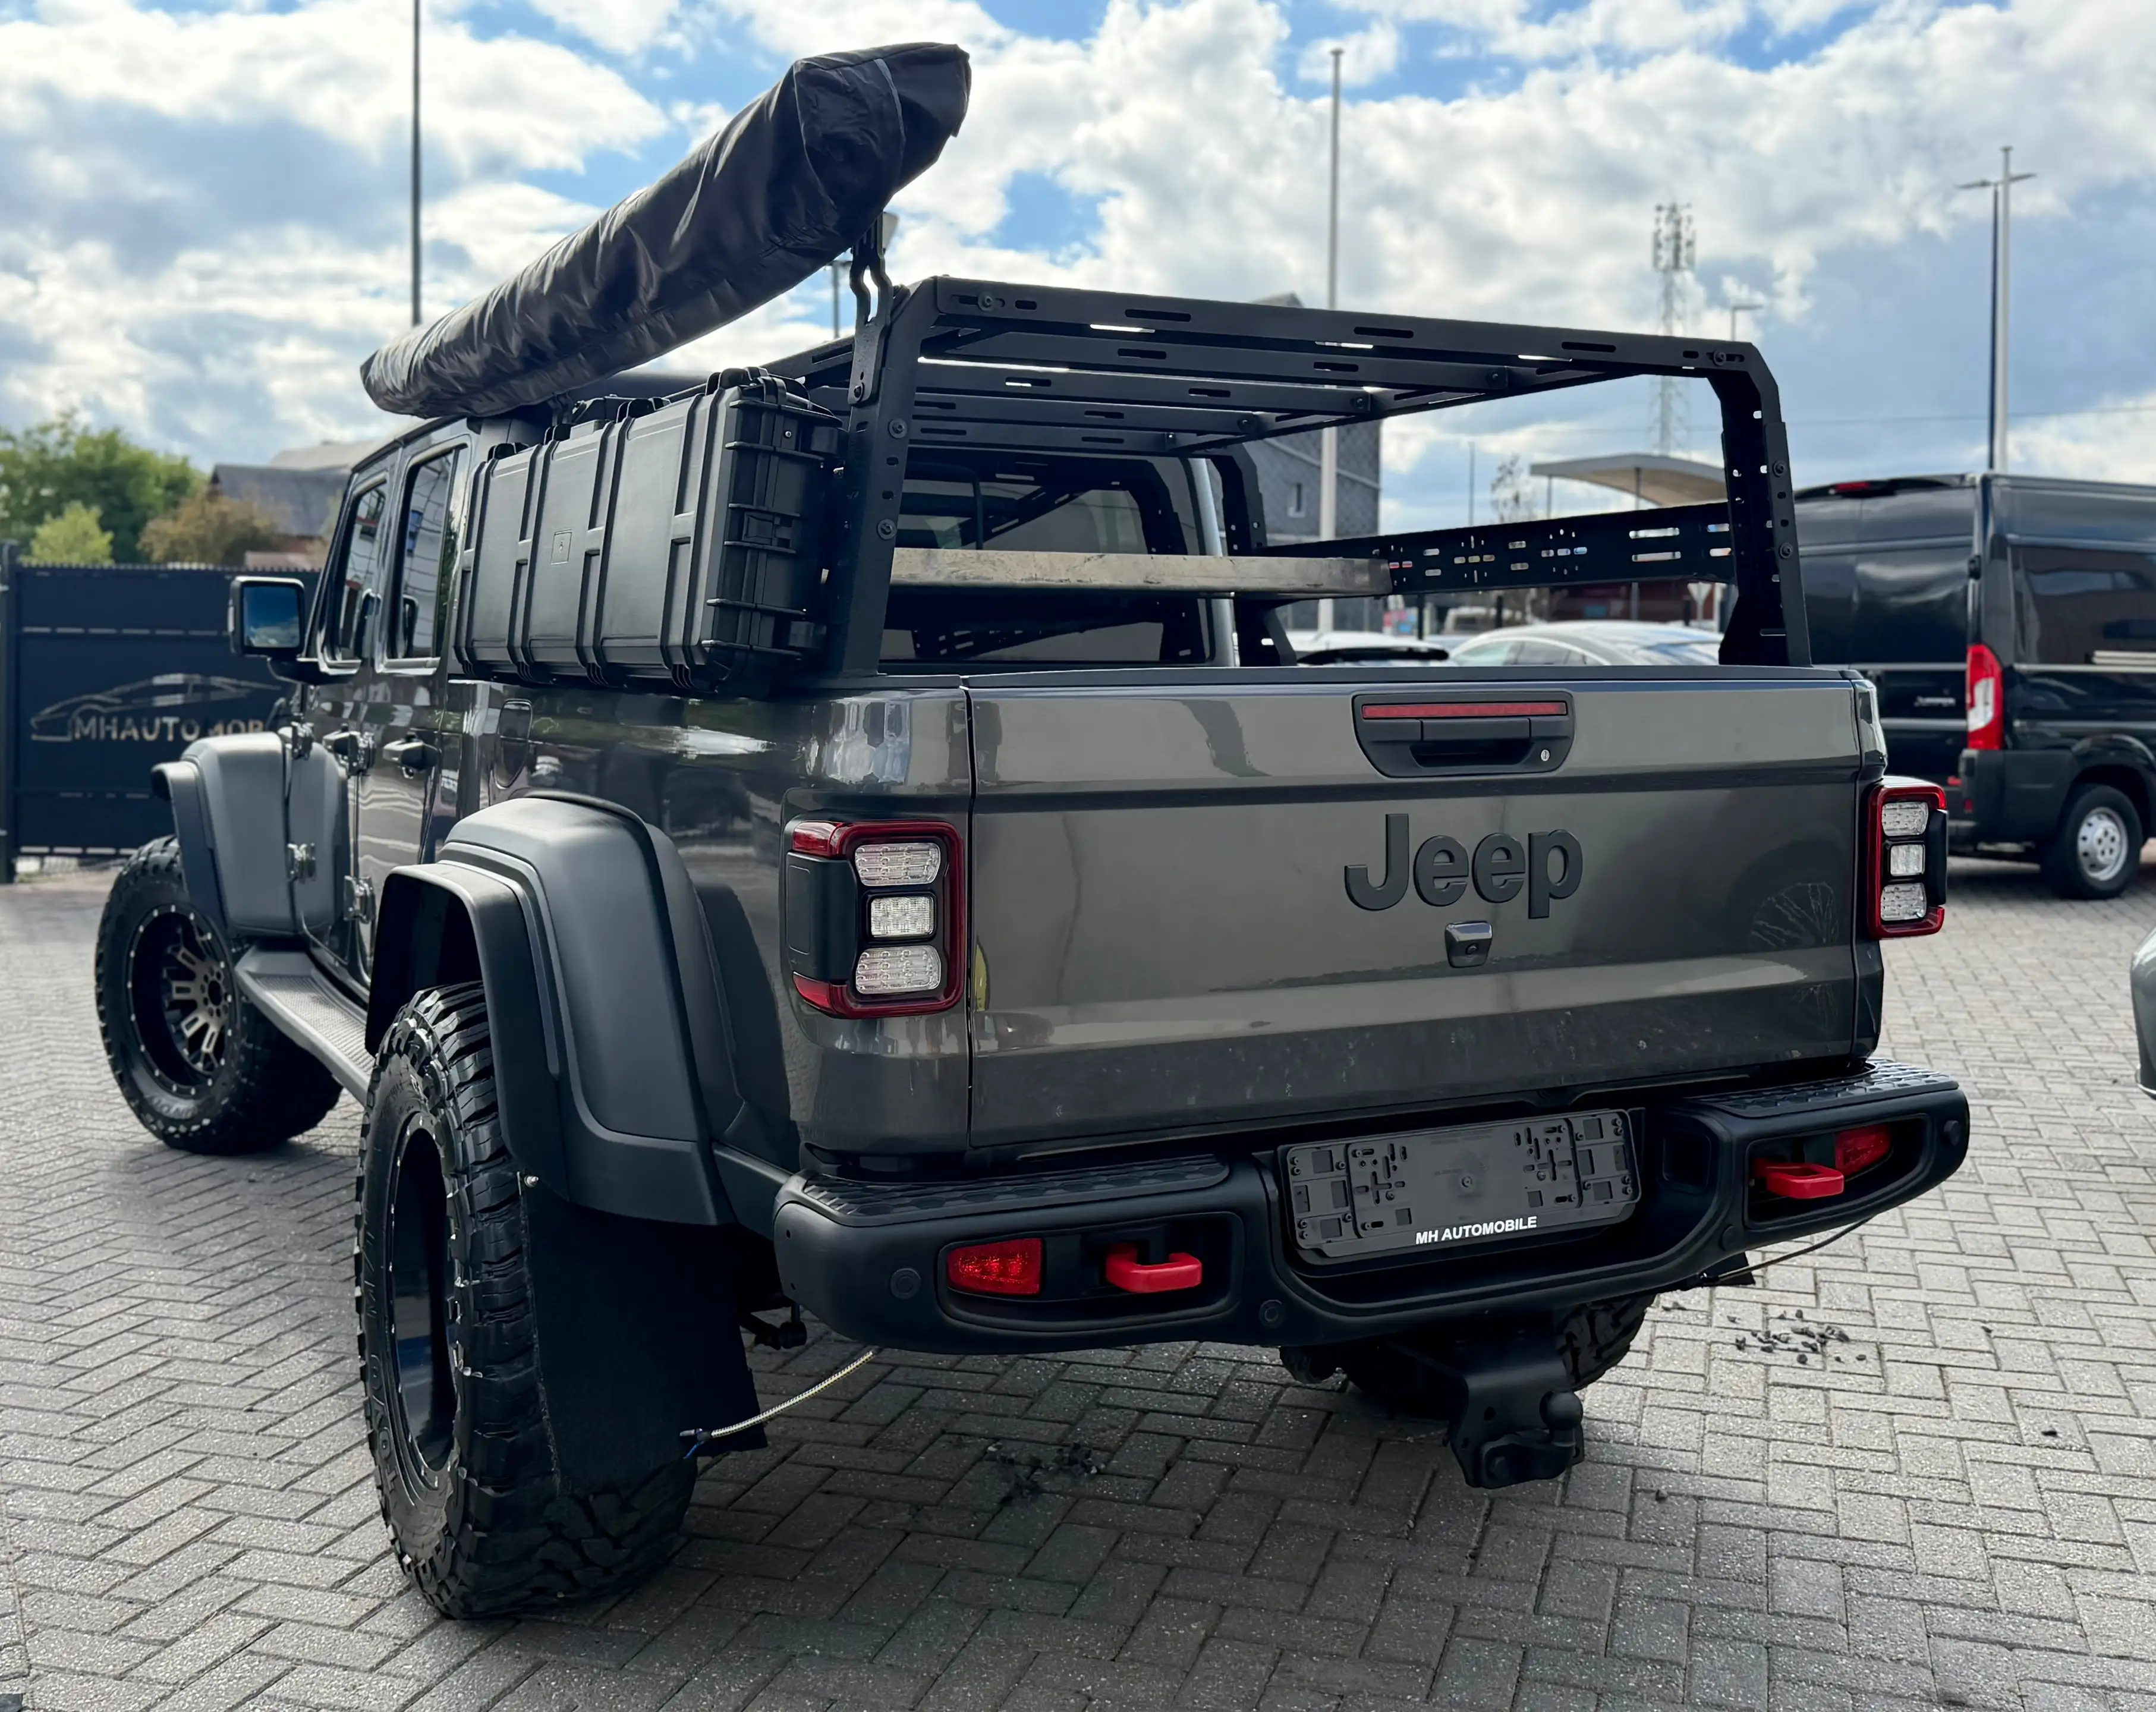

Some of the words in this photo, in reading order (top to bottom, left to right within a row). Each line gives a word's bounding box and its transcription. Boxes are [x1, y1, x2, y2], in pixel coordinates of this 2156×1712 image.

[1344, 813, 1583, 919] Jeep
[1415, 1230, 1439, 1245] MH
[1441, 1216, 1537, 1241] AUTOMOBILE
[369, 1354, 399, 1493] TOYO
